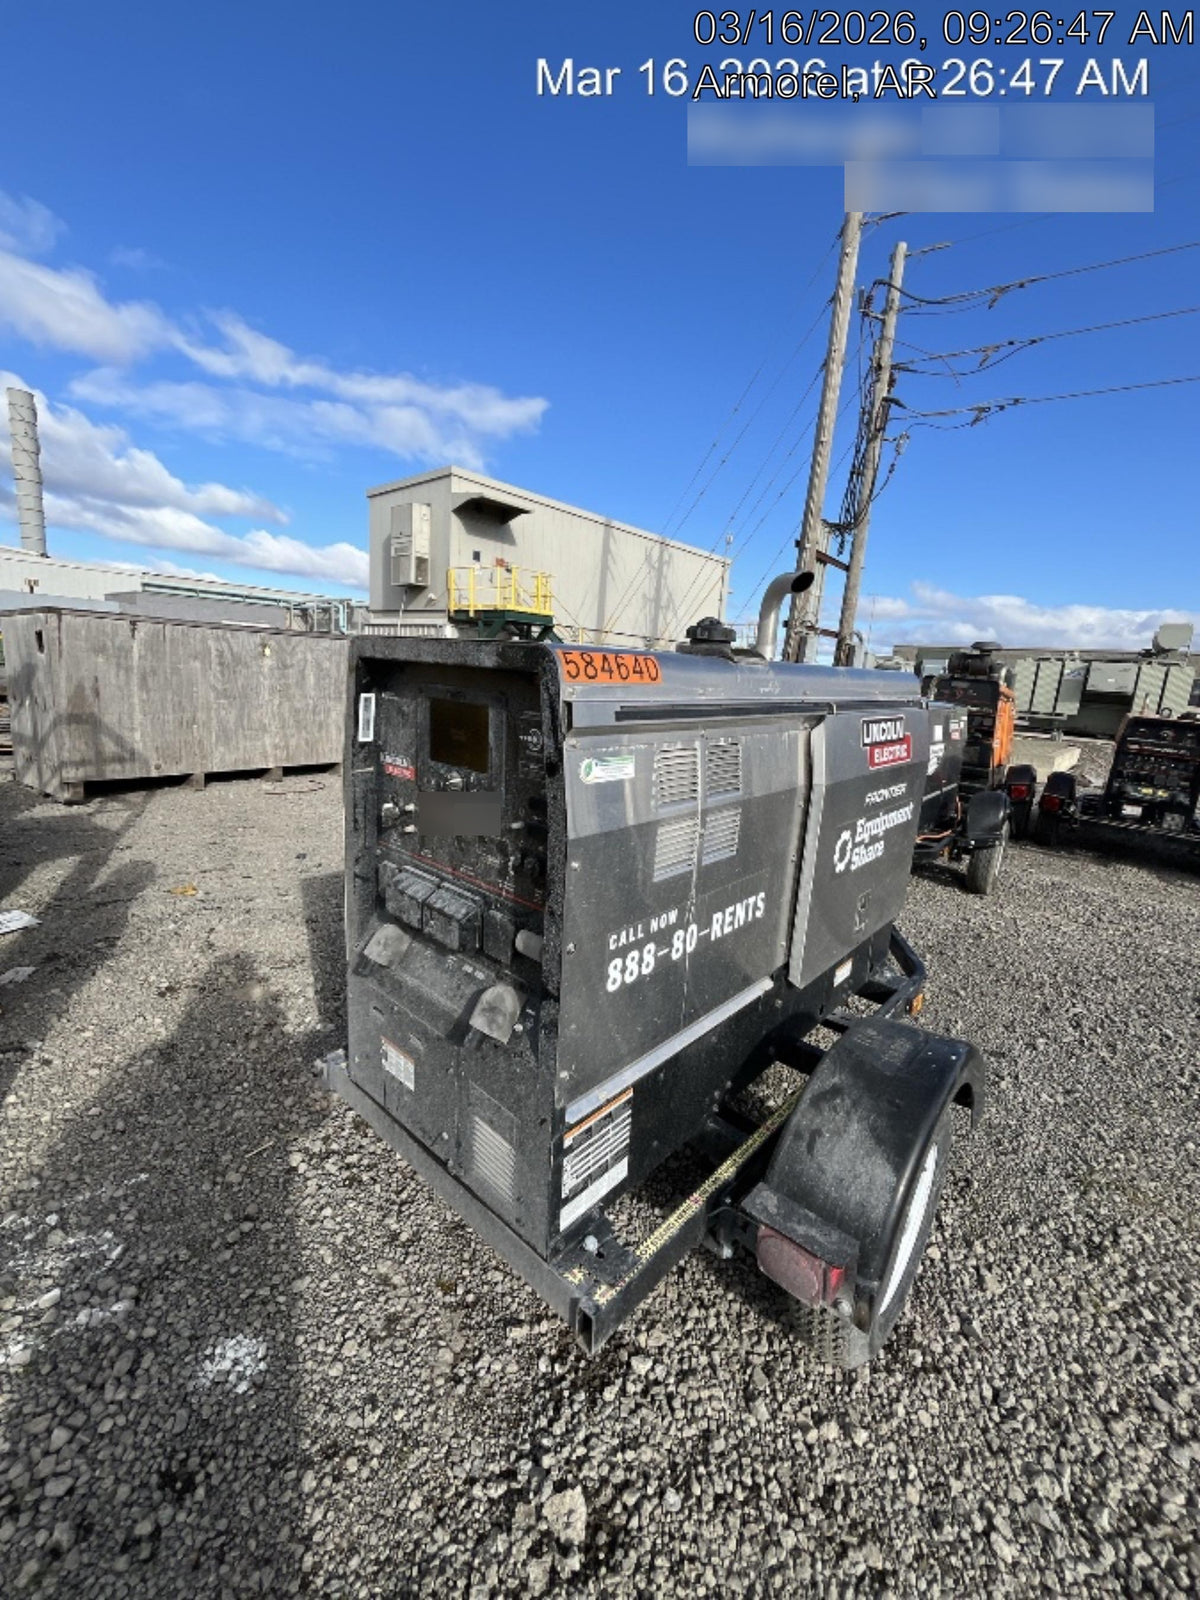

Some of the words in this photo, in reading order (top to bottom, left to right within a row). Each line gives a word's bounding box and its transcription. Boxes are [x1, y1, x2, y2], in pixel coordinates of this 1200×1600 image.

[562, 652, 659, 681] 584640
[863, 720, 904, 745] LINCOLN
[873, 743, 908, 765] ELECTRIC
[854, 801, 914, 844] Equipment
[850, 840, 885, 872] Share
[606, 892, 766, 992] 888-80-RENTS
[609, 923, 645, 950] CALL
[650, 908, 679, 934] NOW
